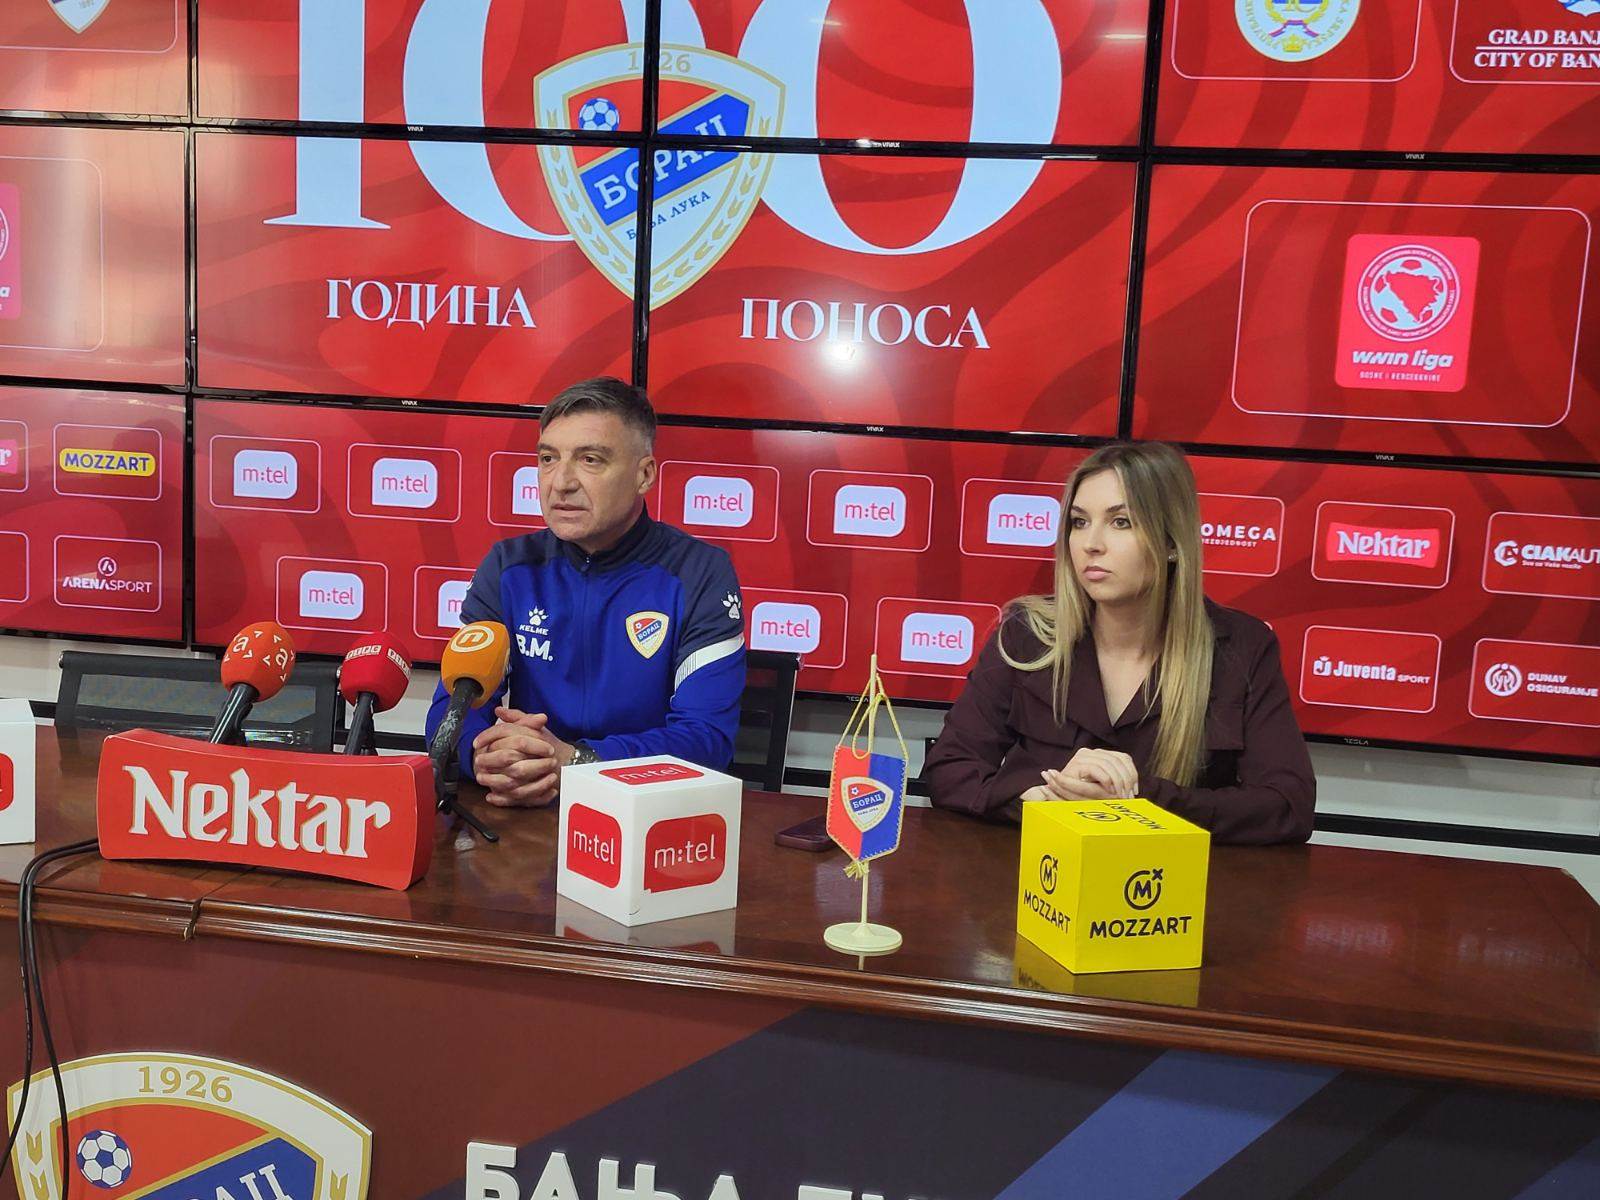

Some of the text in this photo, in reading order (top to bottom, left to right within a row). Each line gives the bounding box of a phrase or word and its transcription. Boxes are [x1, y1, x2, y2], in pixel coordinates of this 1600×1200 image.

[1488, 29, 1549, 45] GRAD
[627, 51, 691, 73] 126
[1474, 52, 1526, 68] CITY
[1528, 52, 1559, 68] OF
[670, 191, 712, 219] ЛУКА
[326, 278, 537, 331] ГОДИНА
[739, 297, 990, 350] ПОНОСА
[1411, 349, 1454, 371] liga
[64, 453, 150, 472] MOZZART
[242, 465, 289, 485] m:tel
[381, 474, 429, 494] m:tel
[693, 492, 744, 512] m:tel
[844, 502, 896, 522] m:tel
[997, 511, 1051, 531] m:tel
[1200, 523, 1277, 541] OMEGA
[1336, 530, 1431, 559] Nektar
[309, 587, 355, 605] m:tel
[519, 624, 549, 636] KELME
[760, 619, 811, 638] m:tel
[515, 633, 554, 662] B.M.
[911, 630, 964, 650] m:tel
[1333, 660, 1431, 684] Juventa SPORT
[1527, 672, 1568, 683] DUNAV
[1526, 683, 1599, 697] OSIGURANJE
[619, 767, 688, 780] m:tel
[852, 793, 883, 809] БОРАЦ
[122, 765, 391, 859] Nektar
[573, 830, 615, 865] m:tel
[654, 834, 716, 869] m:tel
[1023, 889, 1072, 934] MOZZART
[1089, 916, 1193, 939] MOZZART
[138, 1065, 233, 1103] 1926
